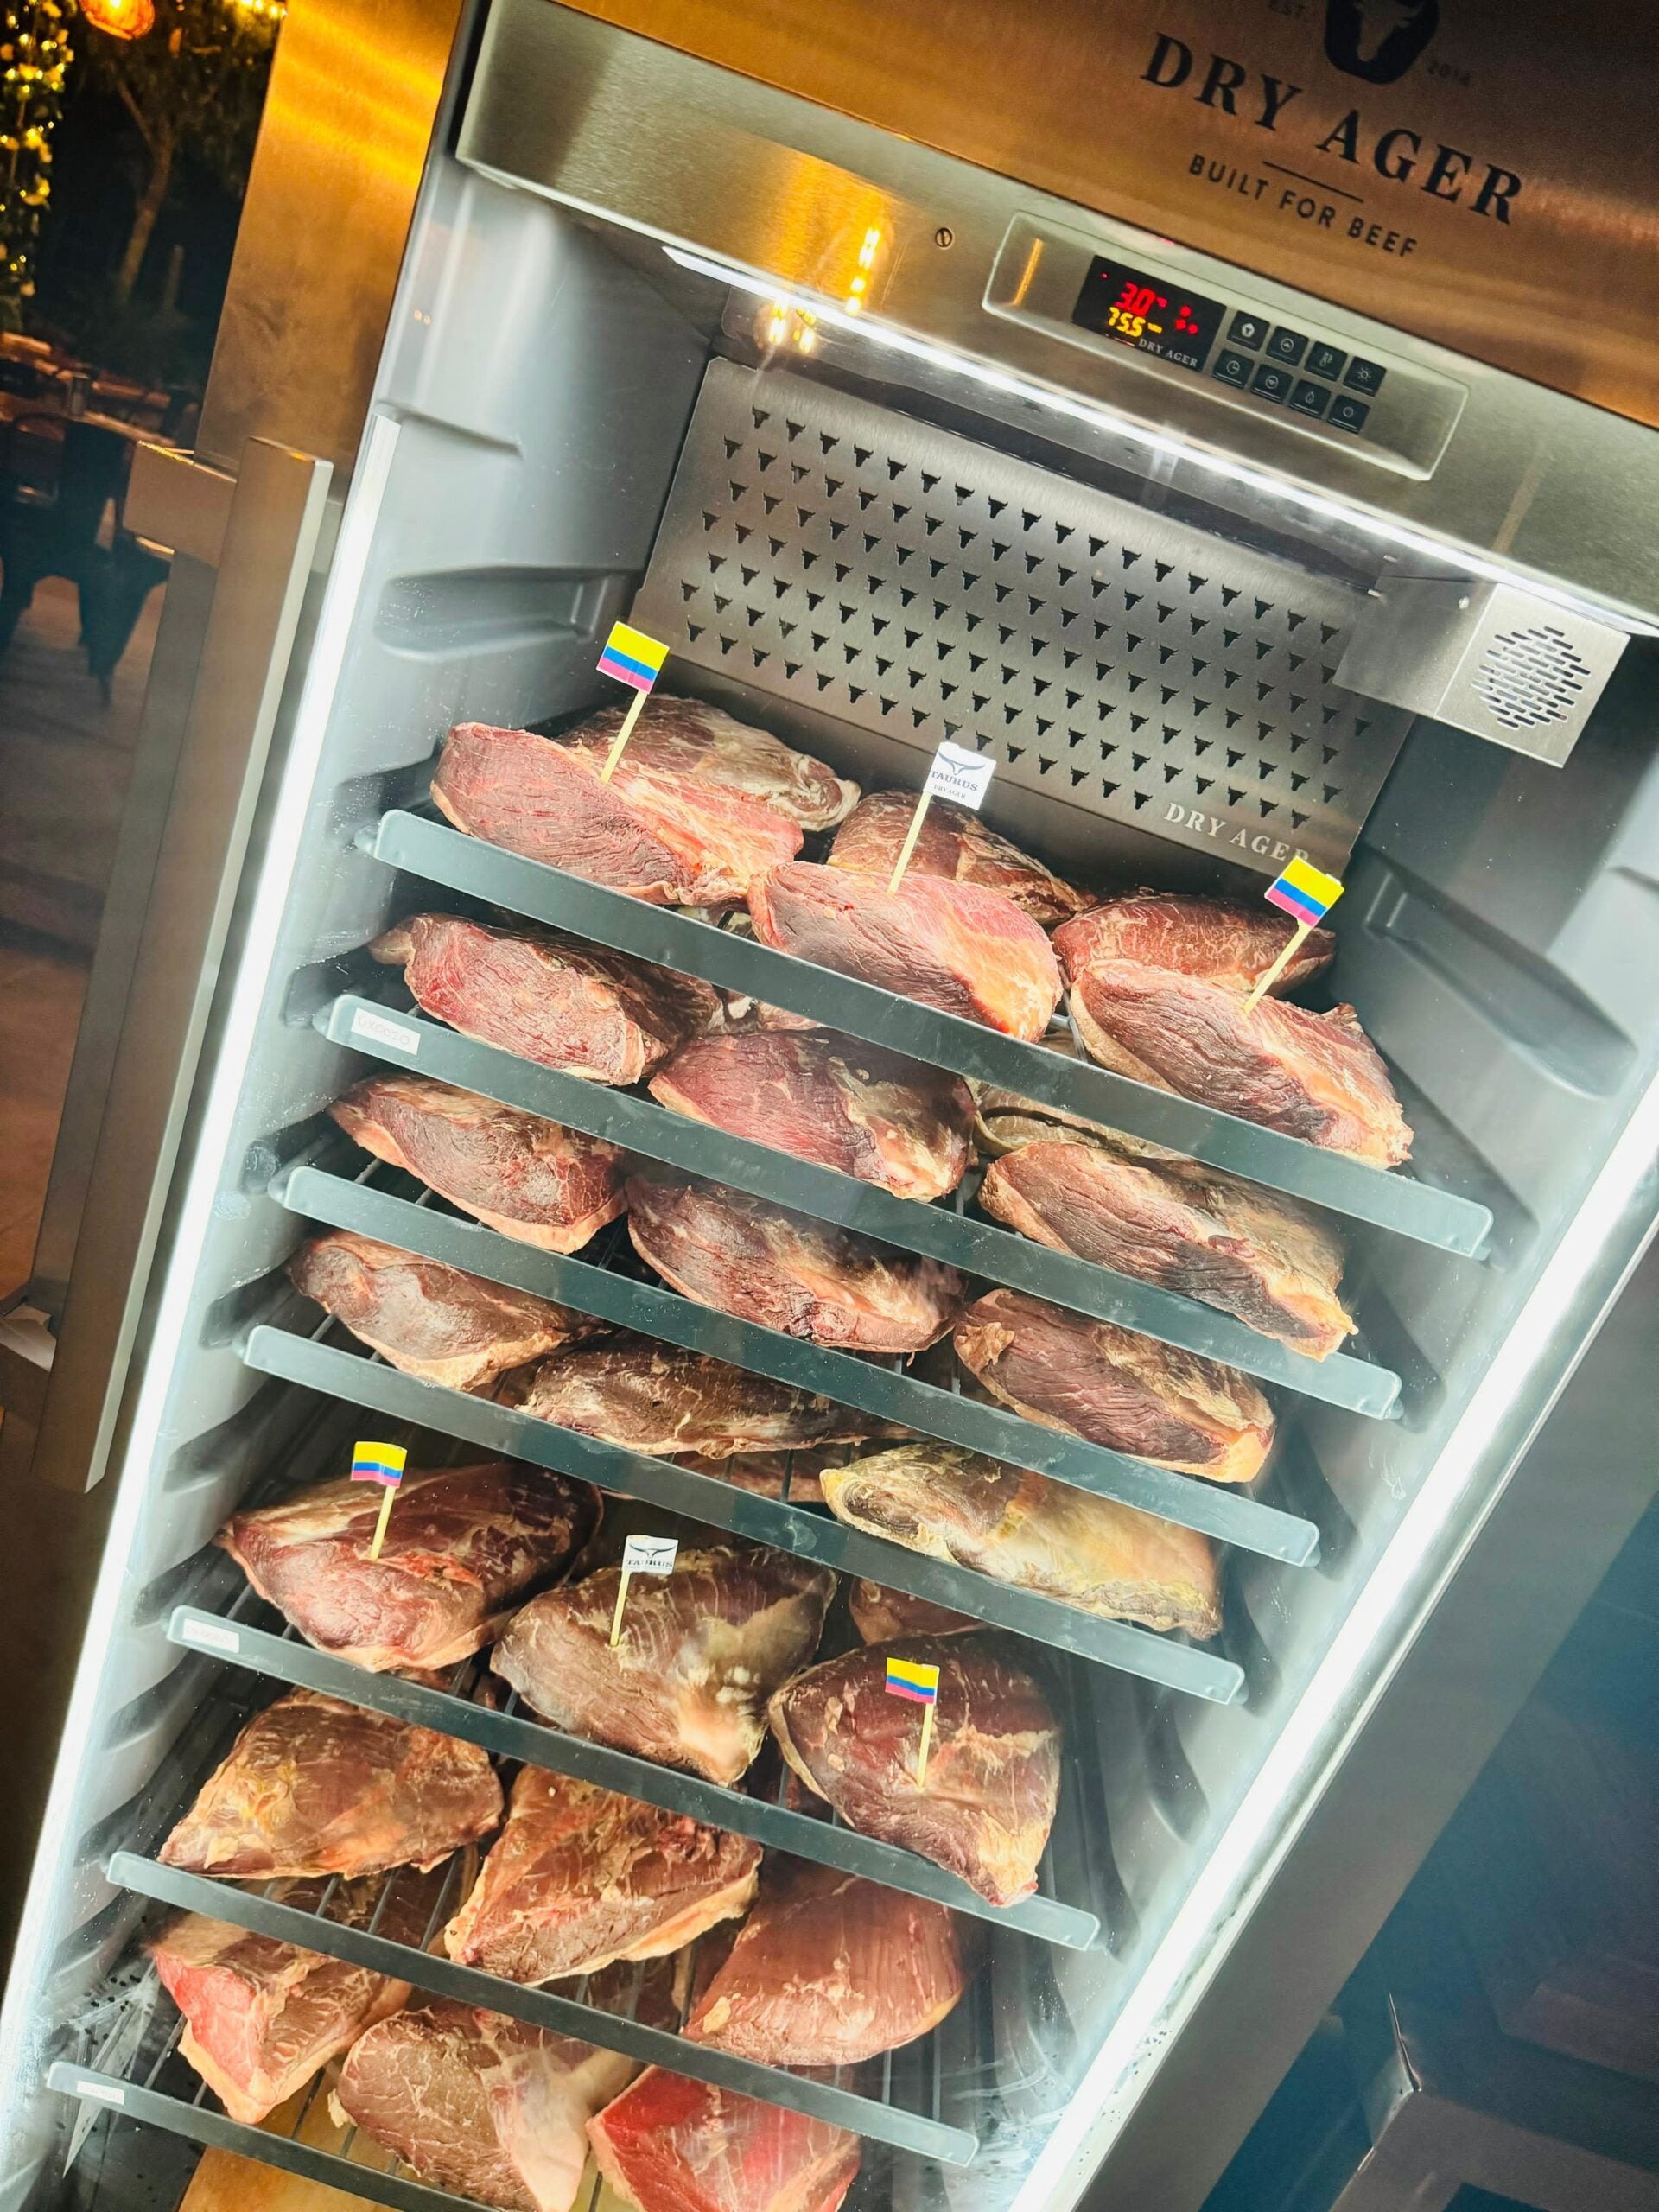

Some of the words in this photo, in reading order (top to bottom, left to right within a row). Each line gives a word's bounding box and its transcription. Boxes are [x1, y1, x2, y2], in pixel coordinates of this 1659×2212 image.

[1140, 32, 1302, 131] DRY
[1315, 109, 1522, 226] AGER
[1189, 154, 1268, 200] BUILT
[1280, 189, 1336, 230] FOR
[1348, 216, 1418, 257] BEEF
[1139, 338, 1163, 353] DRY
[1166, 350, 1198, 367] AGER
[931, 771, 979, 791] TAURUS
[1164, 802, 1226, 837] DRY
